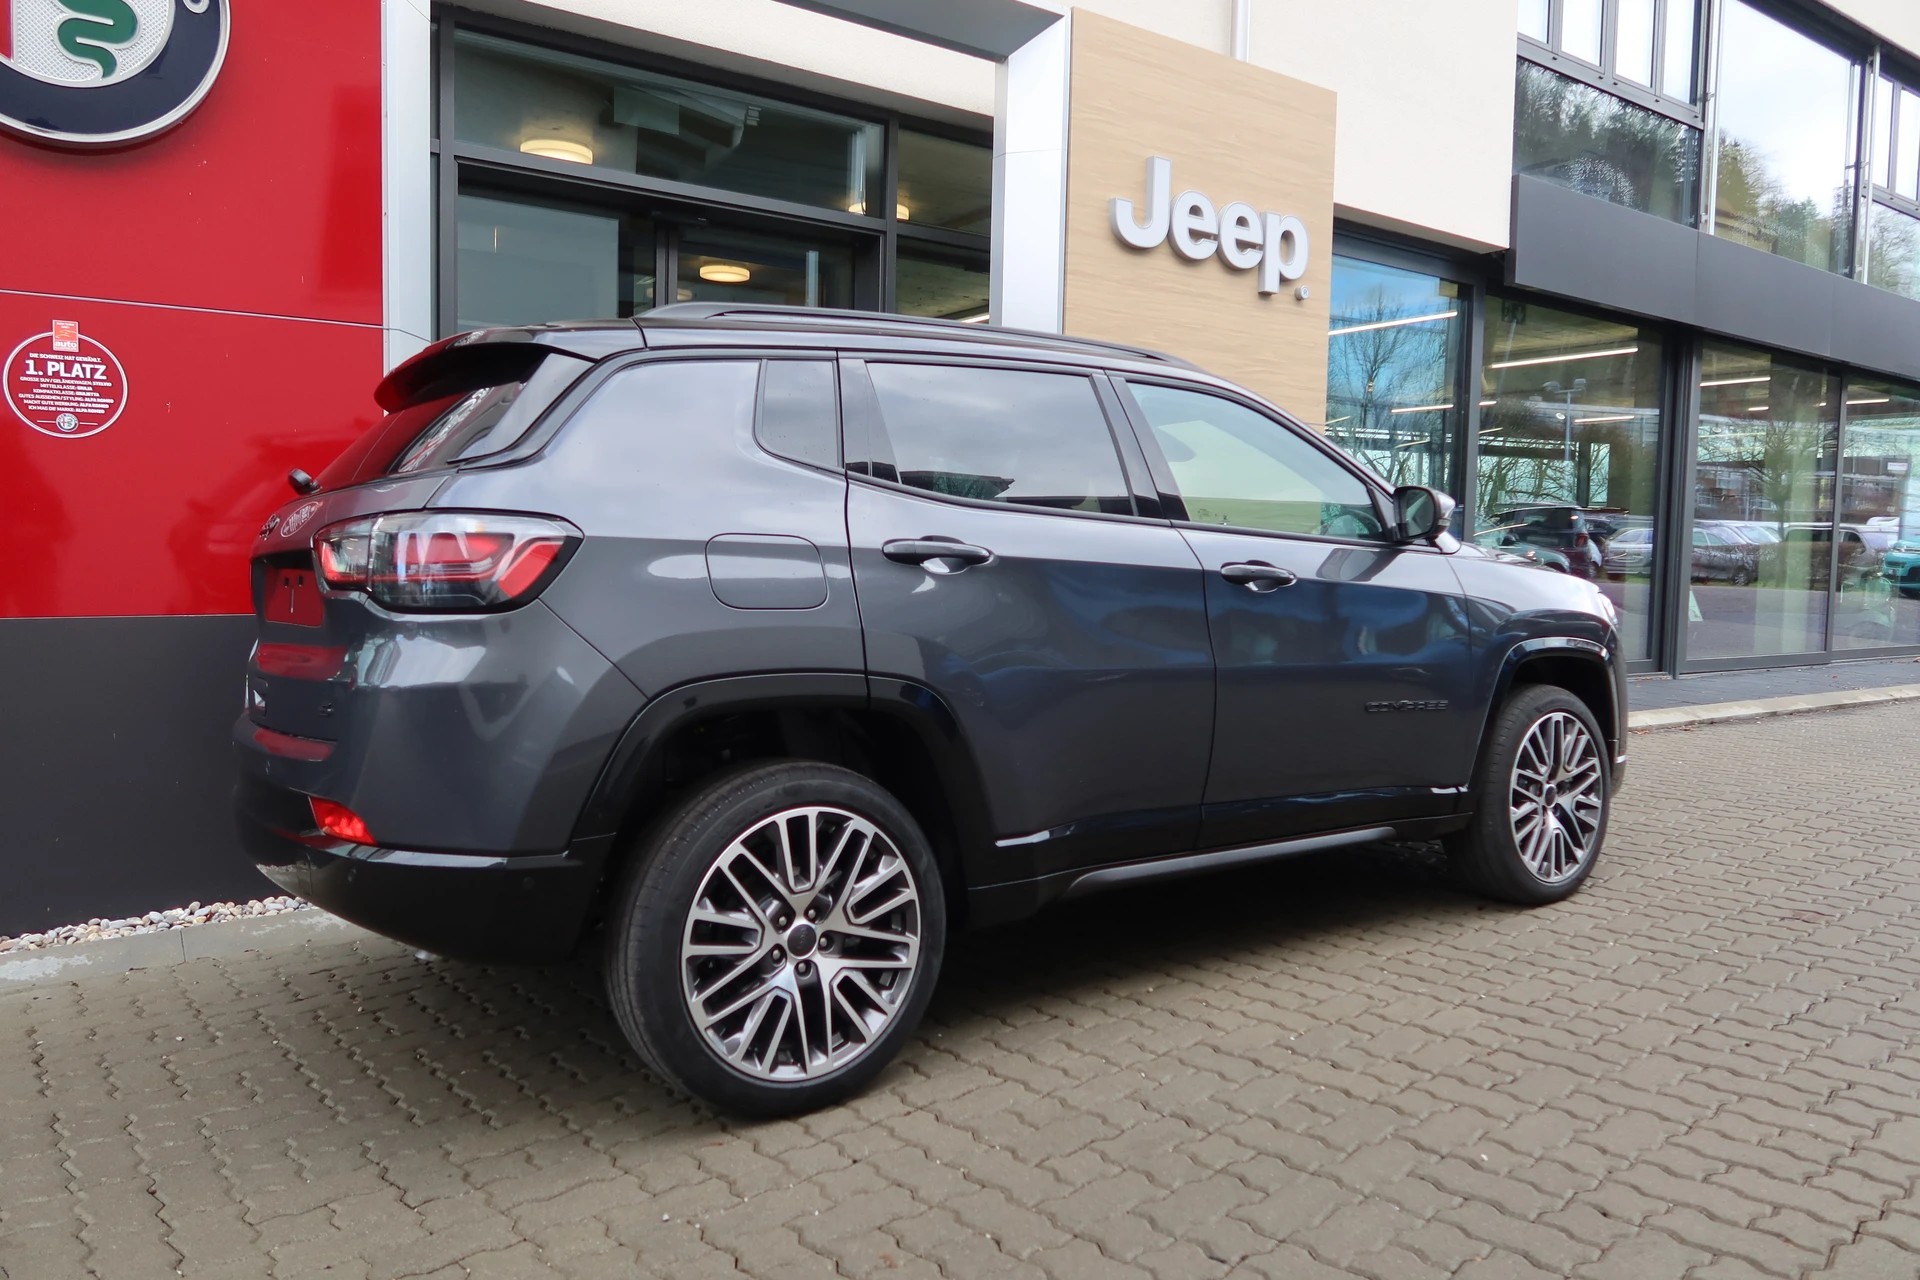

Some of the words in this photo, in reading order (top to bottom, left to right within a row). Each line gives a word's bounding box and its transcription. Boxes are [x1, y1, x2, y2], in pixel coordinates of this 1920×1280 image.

[1109, 155, 1309, 295] Jeep
[25, 360, 43, 375] 1.
[47, 361, 107, 379] PLATZ
